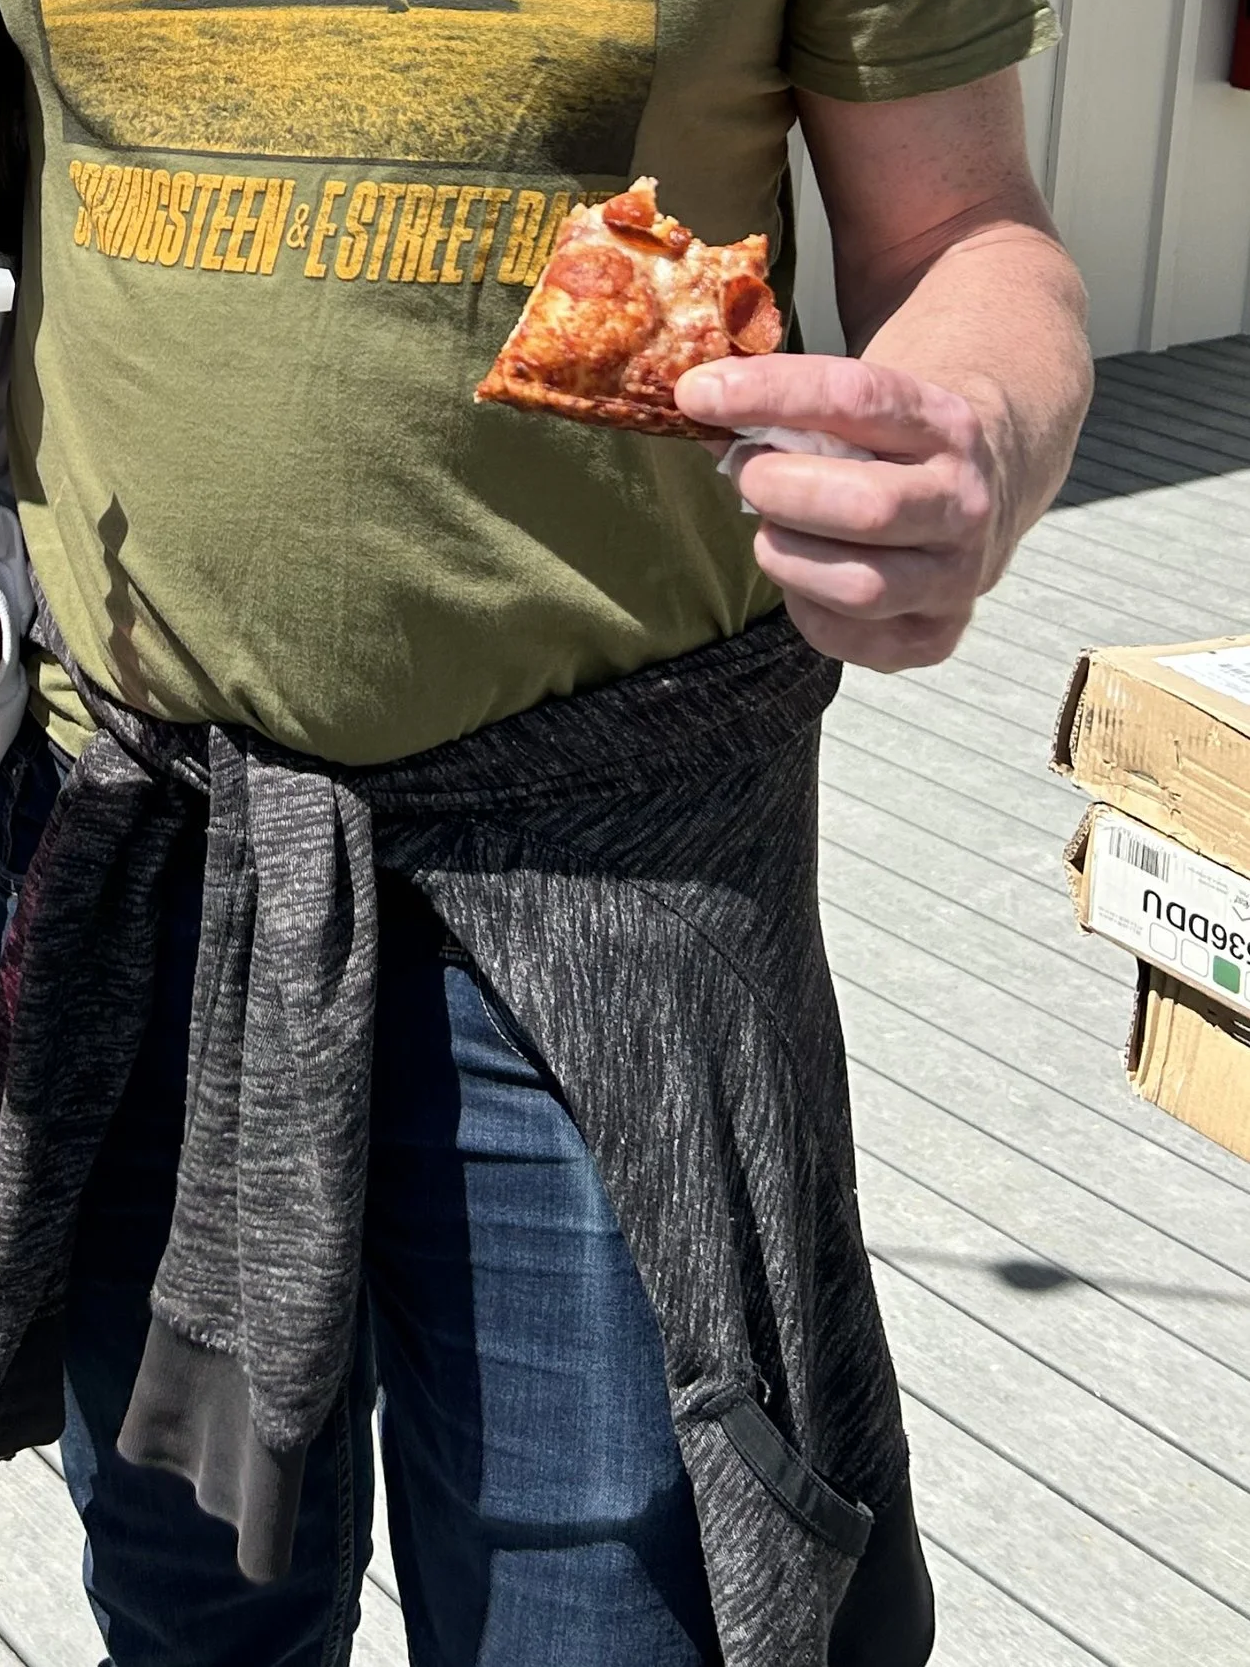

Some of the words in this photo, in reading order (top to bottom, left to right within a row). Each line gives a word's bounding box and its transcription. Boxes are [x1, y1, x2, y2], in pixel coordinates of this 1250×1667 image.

[286, 203, 311, 249] &
[304, 180, 347, 278] E
[334, 180, 513, 283] STREET
[1142, 888, 1250, 966] 36DDU
